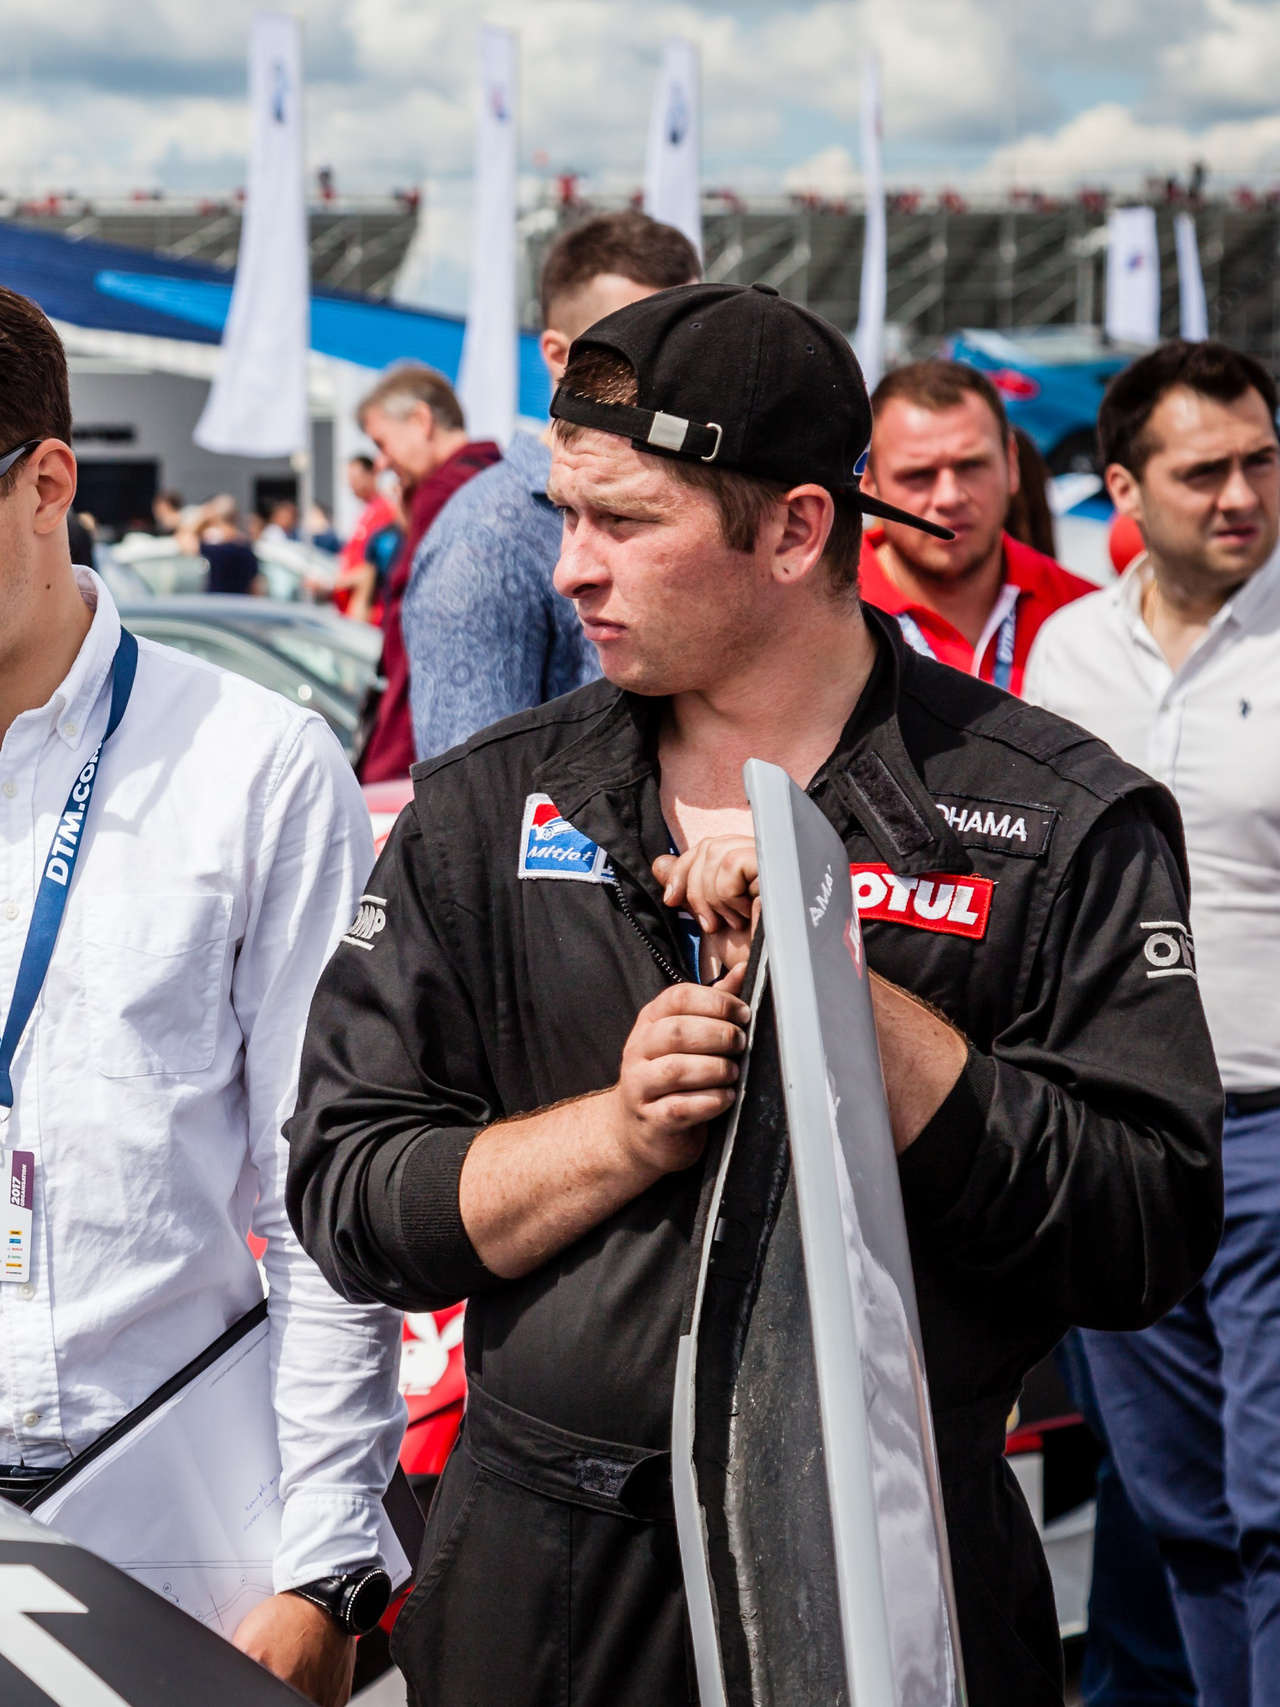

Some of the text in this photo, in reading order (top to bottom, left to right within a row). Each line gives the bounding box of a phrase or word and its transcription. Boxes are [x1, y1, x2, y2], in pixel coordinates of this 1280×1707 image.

[527, 844, 597, 863] Mitjet
[348, 904, 387, 940] MP
[11, 1175, 22, 1206] 2017
